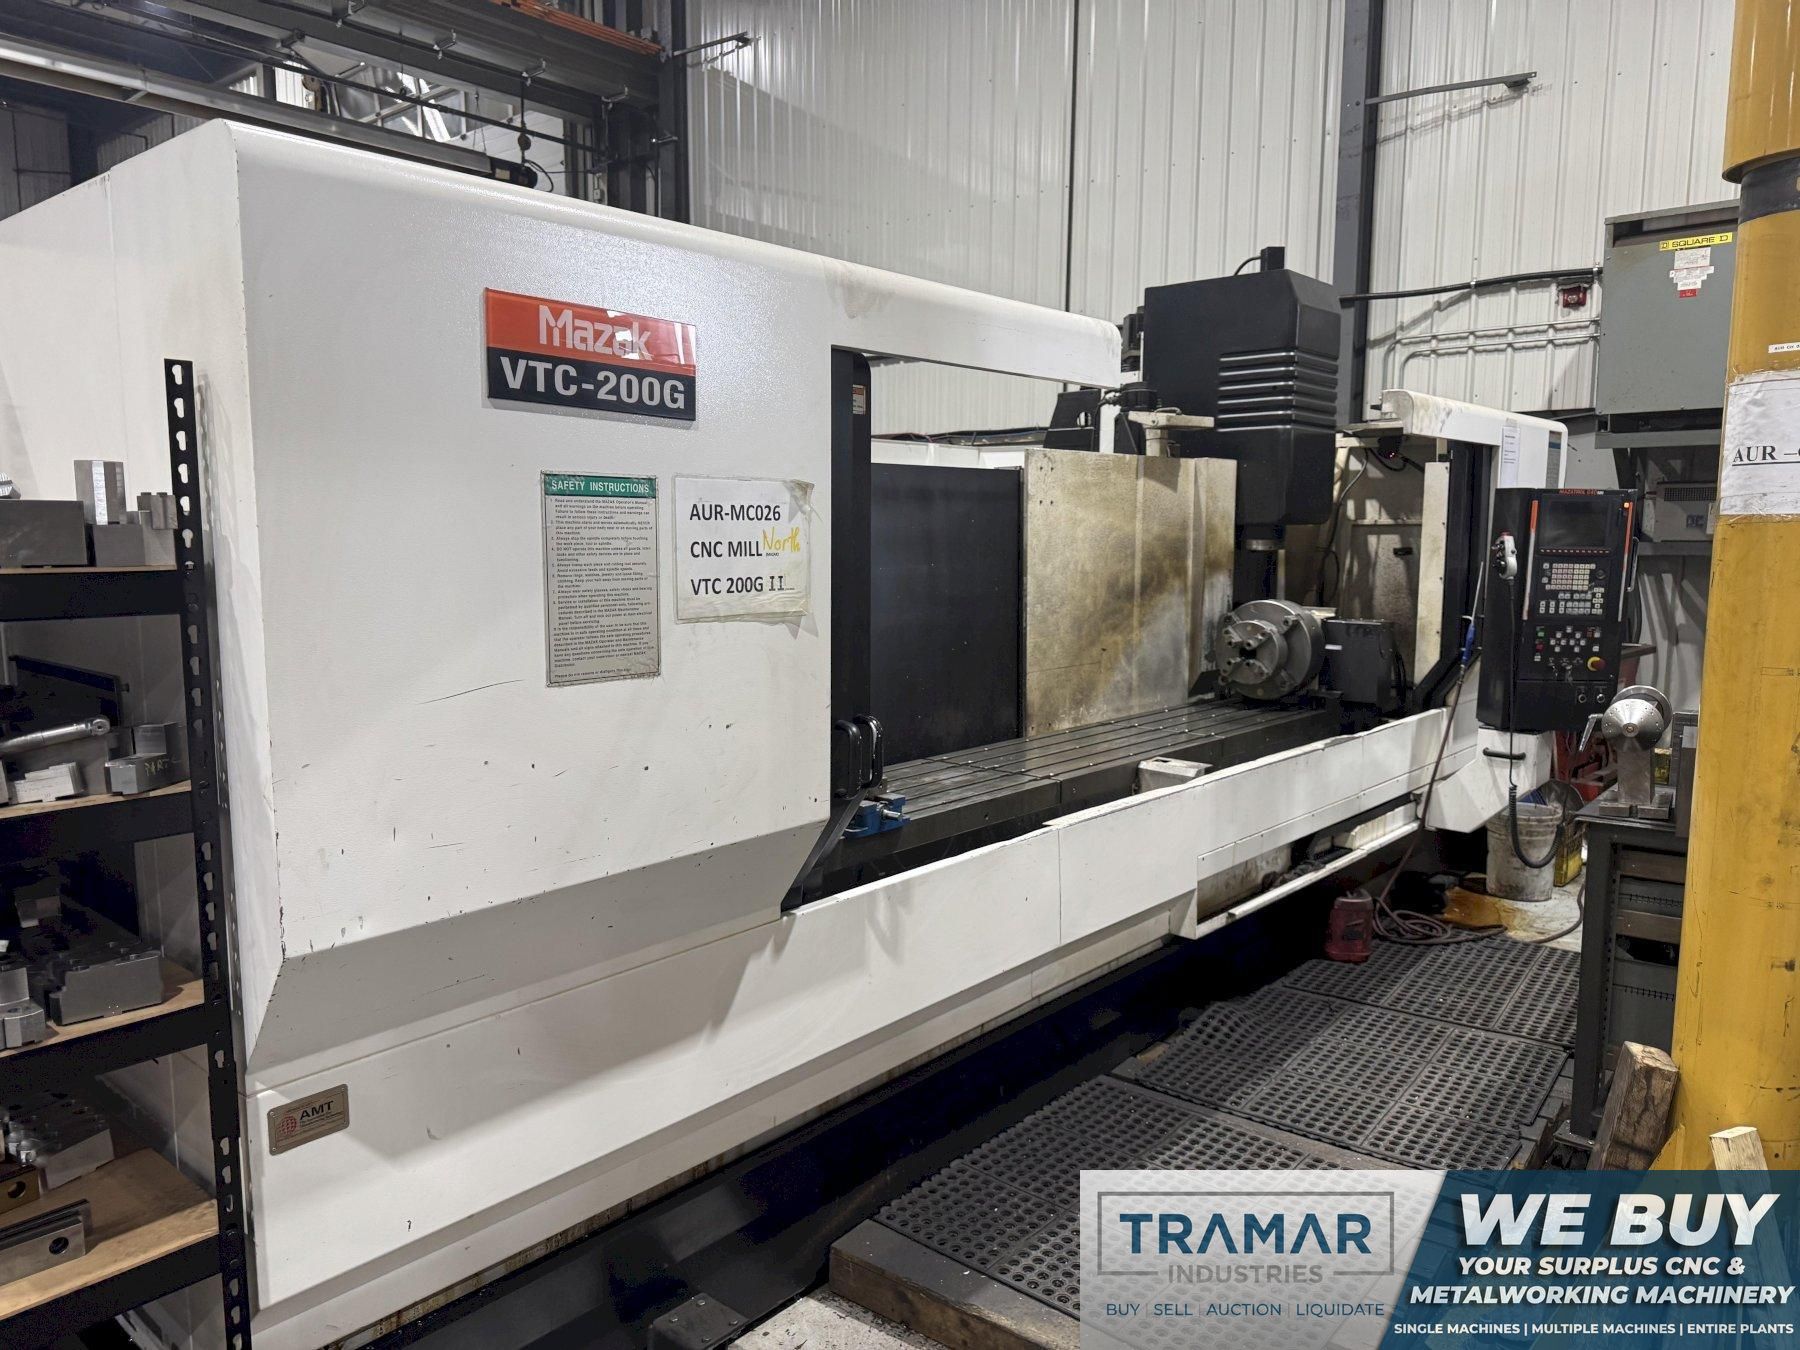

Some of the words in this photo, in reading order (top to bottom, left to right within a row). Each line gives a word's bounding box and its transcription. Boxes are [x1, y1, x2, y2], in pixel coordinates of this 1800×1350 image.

[1672, 236, 1716, 248] SQUARE
[538, 305, 652, 359] Mazak
[500, 357, 685, 410] VTC-200G
[1733, 446, 1779, 463] AUR
[551, 480, 585, 491] SAFETY
[590, 482, 650, 493] INSTRUCTIONS
[689, 504, 781, 521] AUR-MC026
[762, 526, 801, 552] North
[690, 541, 722, 558] CNC
[728, 541, 762, 558] MILL
[690, 577, 722, 596] VTC
[726, 576, 763, 593] 200G
[769, 575, 785, 591] II
[300, 1101, 334, 1120] AMT
